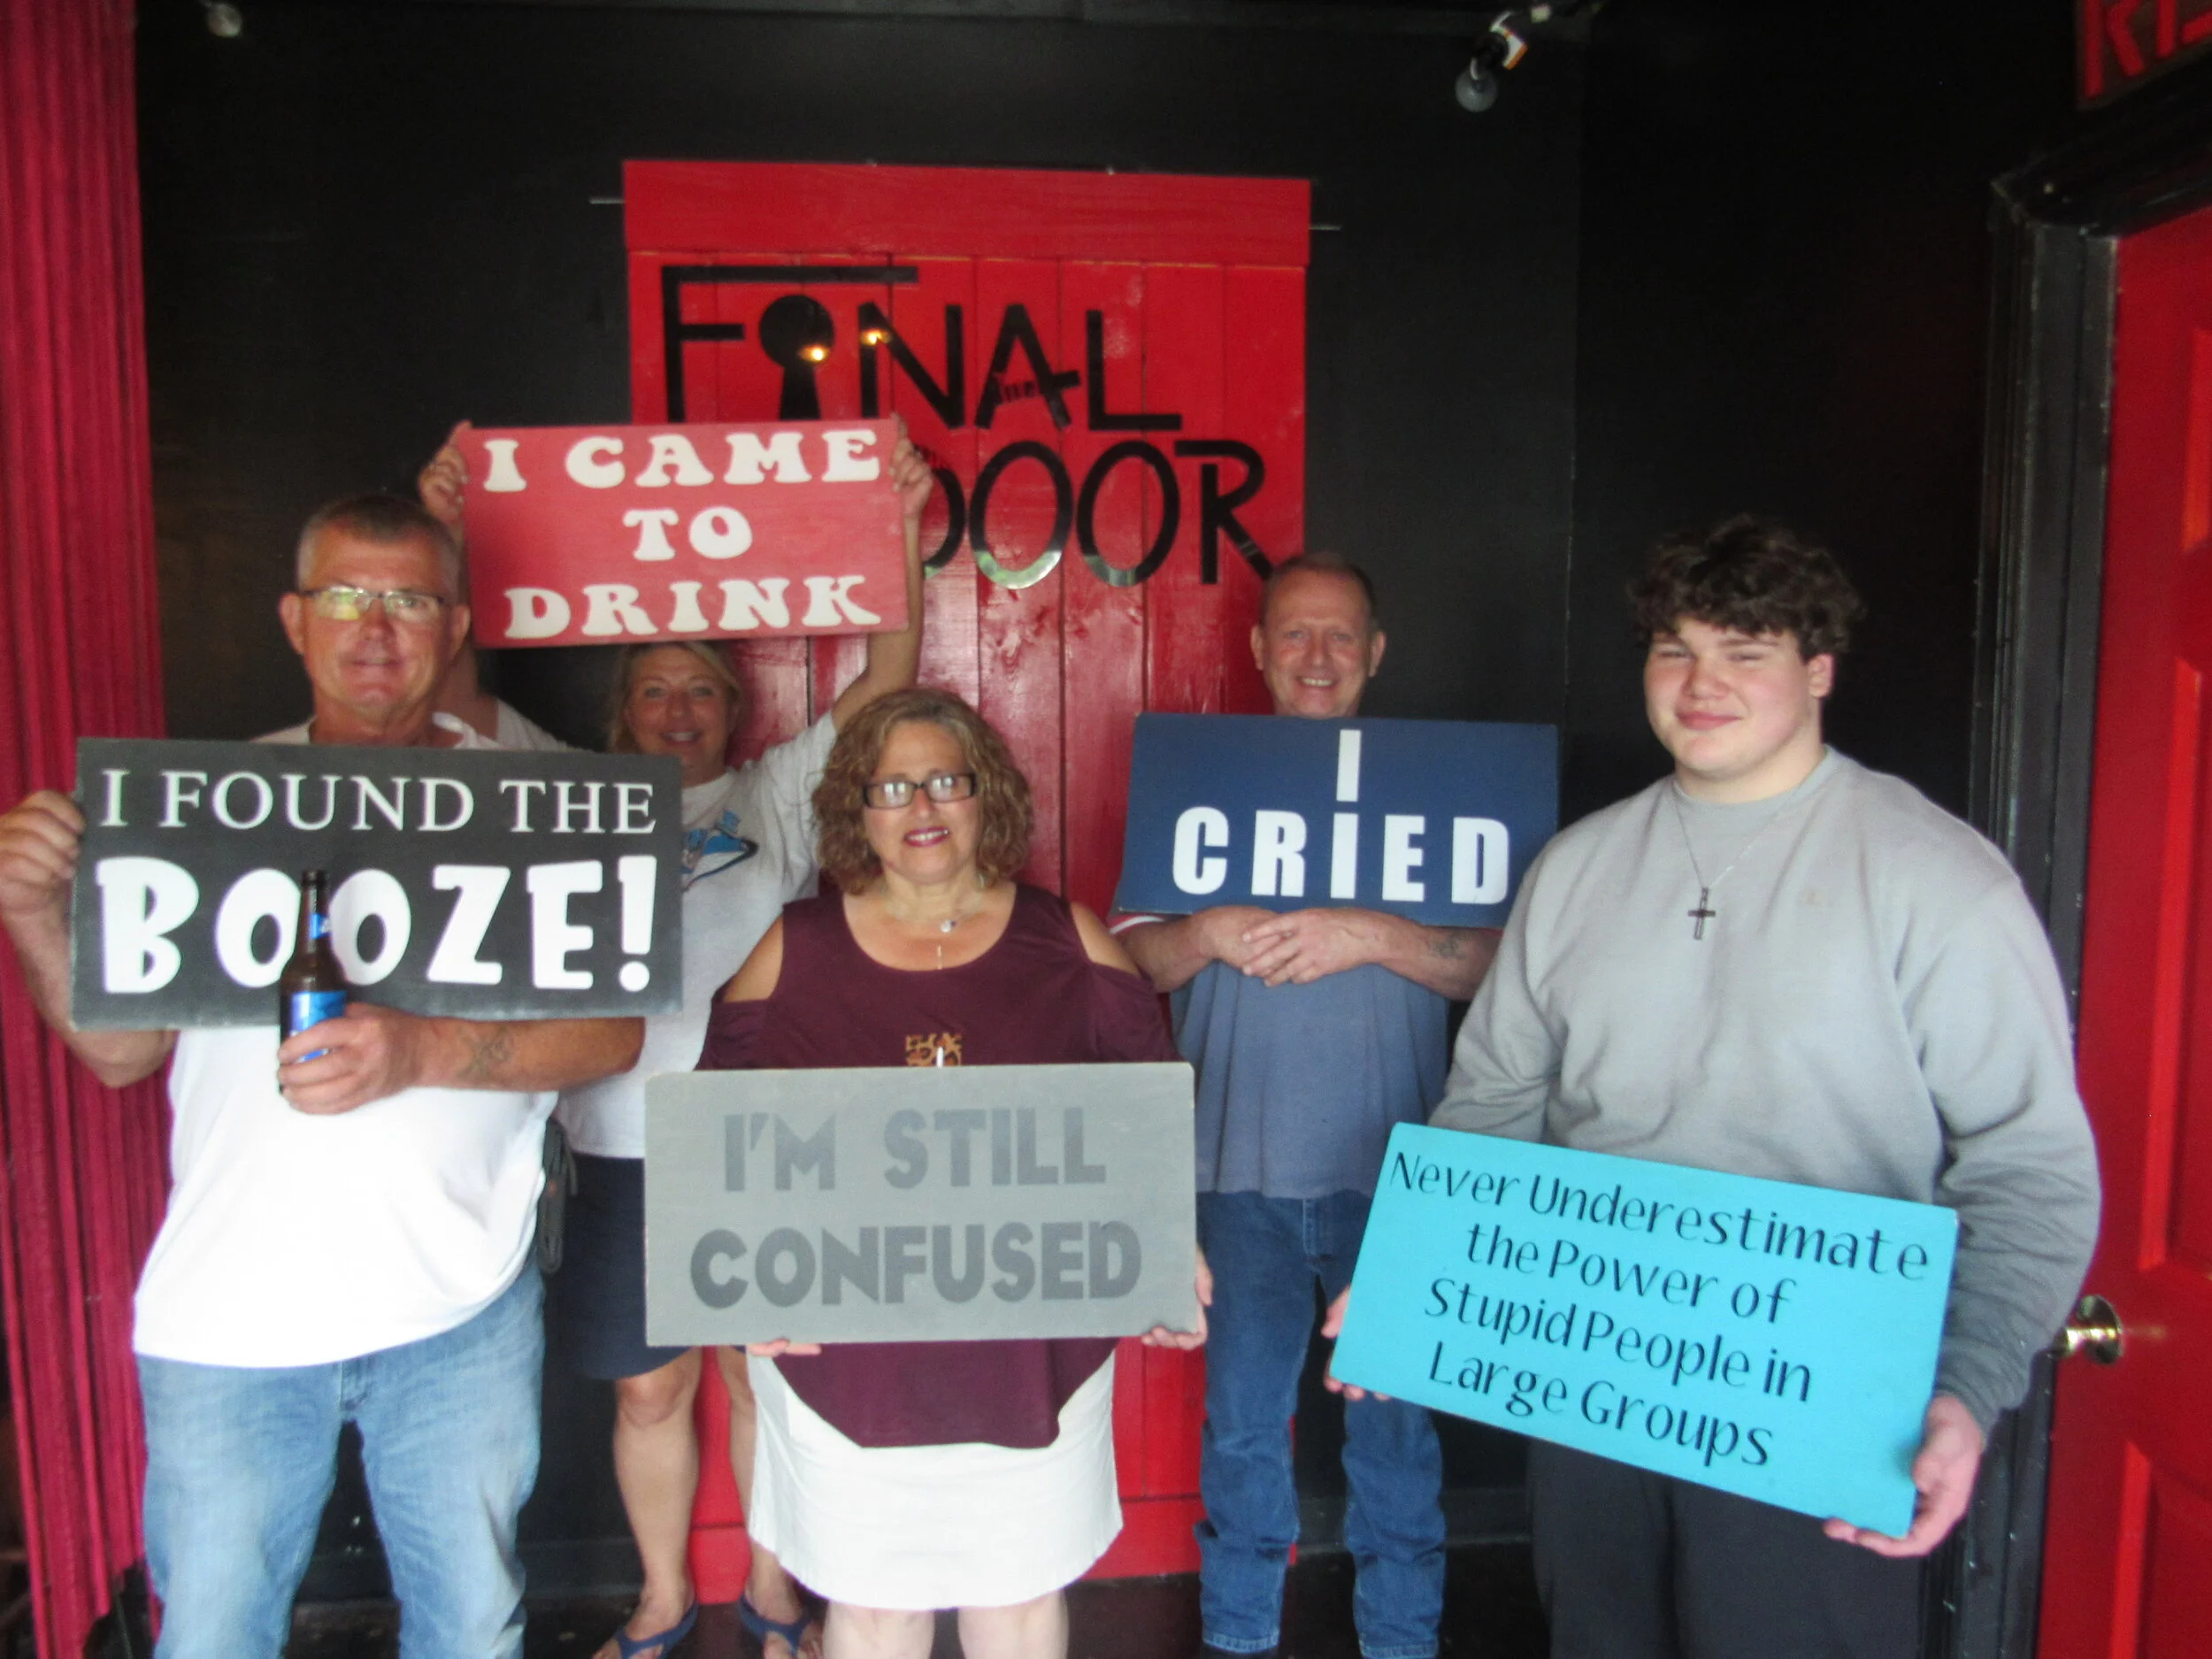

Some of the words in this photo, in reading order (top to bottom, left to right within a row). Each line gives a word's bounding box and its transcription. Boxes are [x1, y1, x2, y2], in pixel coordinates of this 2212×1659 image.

[484, 439, 526, 493] I
[565, 429, 880, 488] CAME
[623, 506, 752, 561] TO
[504, 575, 881, 639] DRINK
[100, 769, 132, 827] I
[158, 770, 475, 832] FOUND
[500, 780, 657, 834] THE
[1336, 729, 1362, 803] I
[1171, 806, 1509, 905] CRIED
[96, 855, 657, 995] BOOZE!
[724, 1113, 836, 1193] I'M
[885, 1107, 1106, 1189] STILL
[1389, 1151, 1521, 1206] Never
[1528, 1173, 1930, 1282] Underestimate
[690, 1220, 1142, 1310] CONFUSED
[1467, 1223, 1540, 1274] the
[1548, 1239, 1718, 1308] Power
[1731, 1278, 1797, 1324] of
[1425, 1278, 1576, 1345] Stupid
[1581, 1310, 1750, 1386] People
[1762, 1348, 1812, 1402] in
[1429, 1340, 1569, 1417] Large
[1580, 1379, 1773, 1467] Groups
